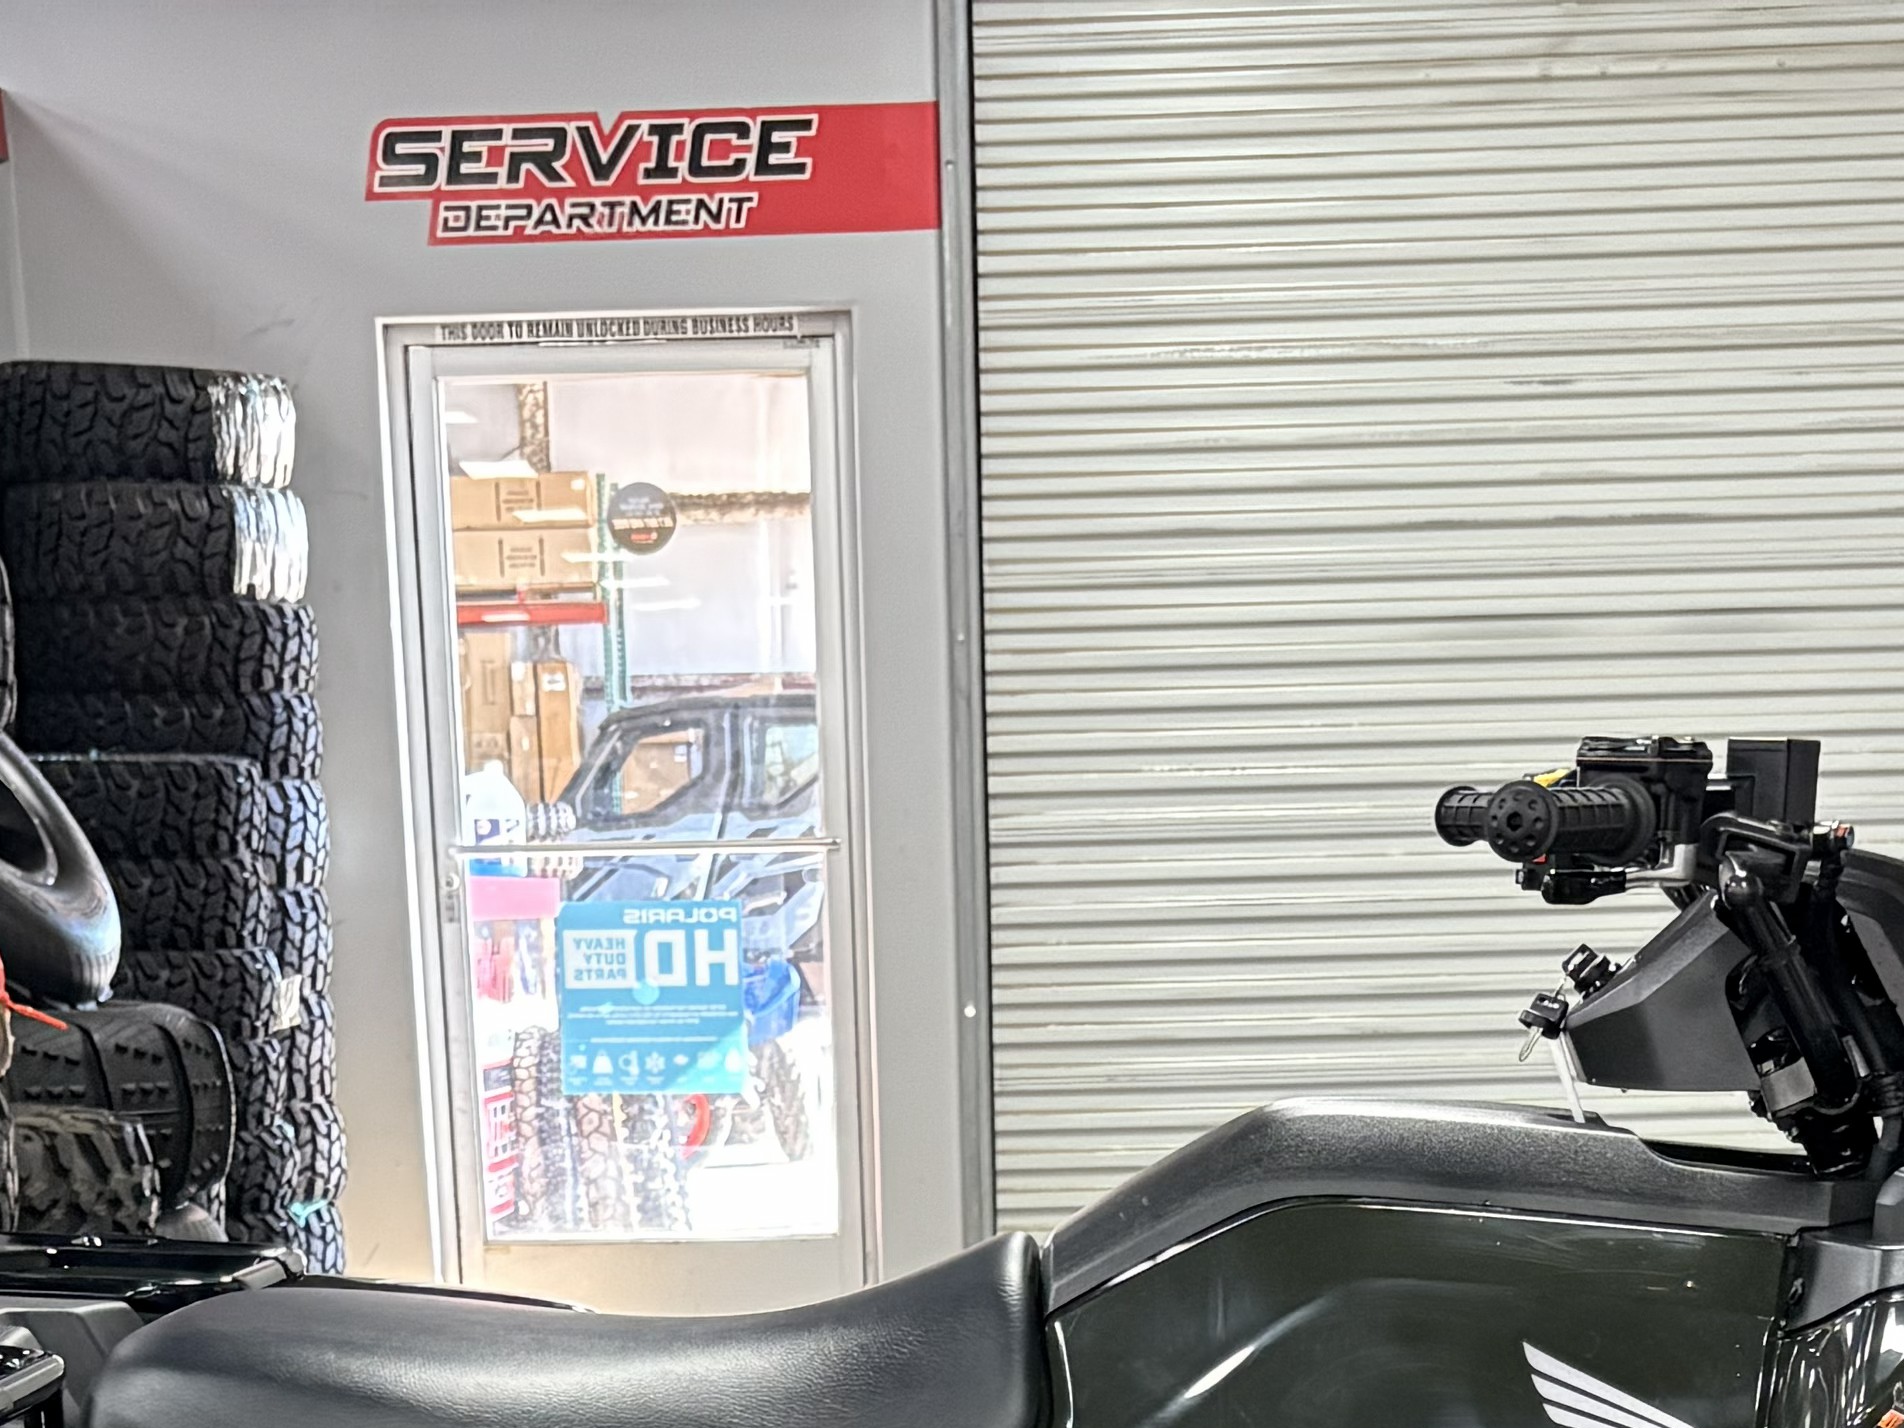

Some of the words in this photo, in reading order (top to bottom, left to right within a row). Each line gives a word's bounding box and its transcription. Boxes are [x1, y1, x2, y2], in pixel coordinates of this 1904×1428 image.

[374, 115, 817, 192] SERVICE
[437, 193, 757, 237] DEPARTMENT
[440, 325, 467, 341] THIS
[471, 323, 504, 340] DOOR
[507, 321, 523, 338] TO
[527, 320, 573, 338] REMAIN
[576, 318, 640, 338] UNLOCKED
[643, 317, 688, 336] DURING
[691, 316, 749, 335] BUSINESS
[753, 314, 794, 333] HOURS
